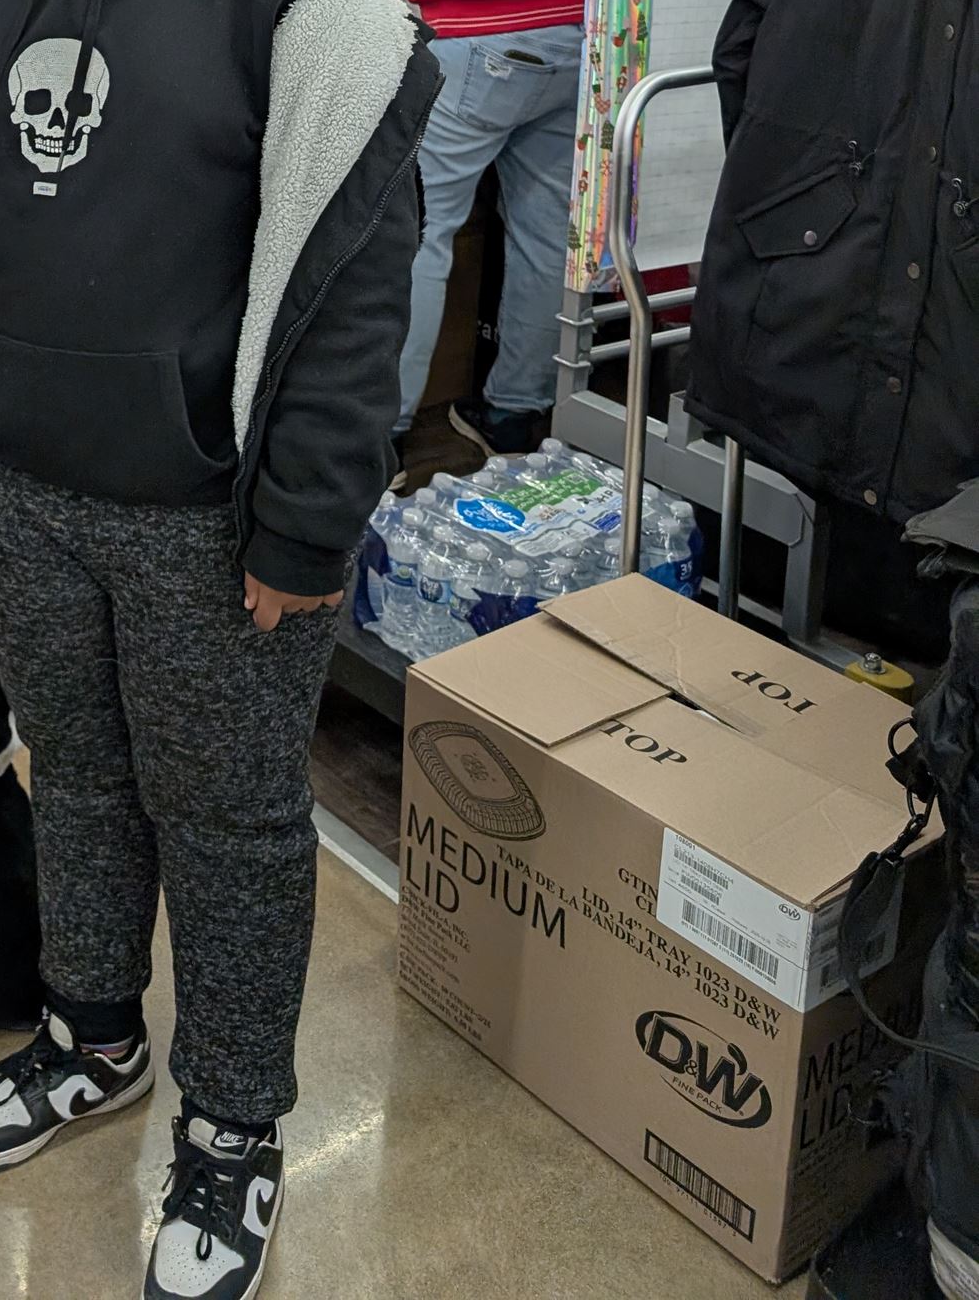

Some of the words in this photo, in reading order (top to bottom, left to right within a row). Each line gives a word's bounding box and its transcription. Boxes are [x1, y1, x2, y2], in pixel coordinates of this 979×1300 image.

[731, 669, 818, 714] TOP
[600, 718, 688, 764] TOP
[405, 846, 460, 914] LID
[407, 803, 566, 949] MEDIUM
[496, 844, 533, 879] TAPA
[534, 872, 556, 894] DE
[558, 885, 579, 912] LA
[582, 904, 662, 967] BANDEJA,
[694, 977, 730, 1009] 1023
[732, 1000, 780, 1041] D&W
[582, 887, 614, 919] LID,
[646, 928, 692, 968] TRAY
[695, 961, 730, 992] 1023
[734, 985, 782, 1024] D&W
[646, 1013, 763, 1112] D&W
[672, 1076, 695, 1096] FINE
[697, 1092, 723, 1112] PACK
[221, 1131, 244, 1143] NIKE
